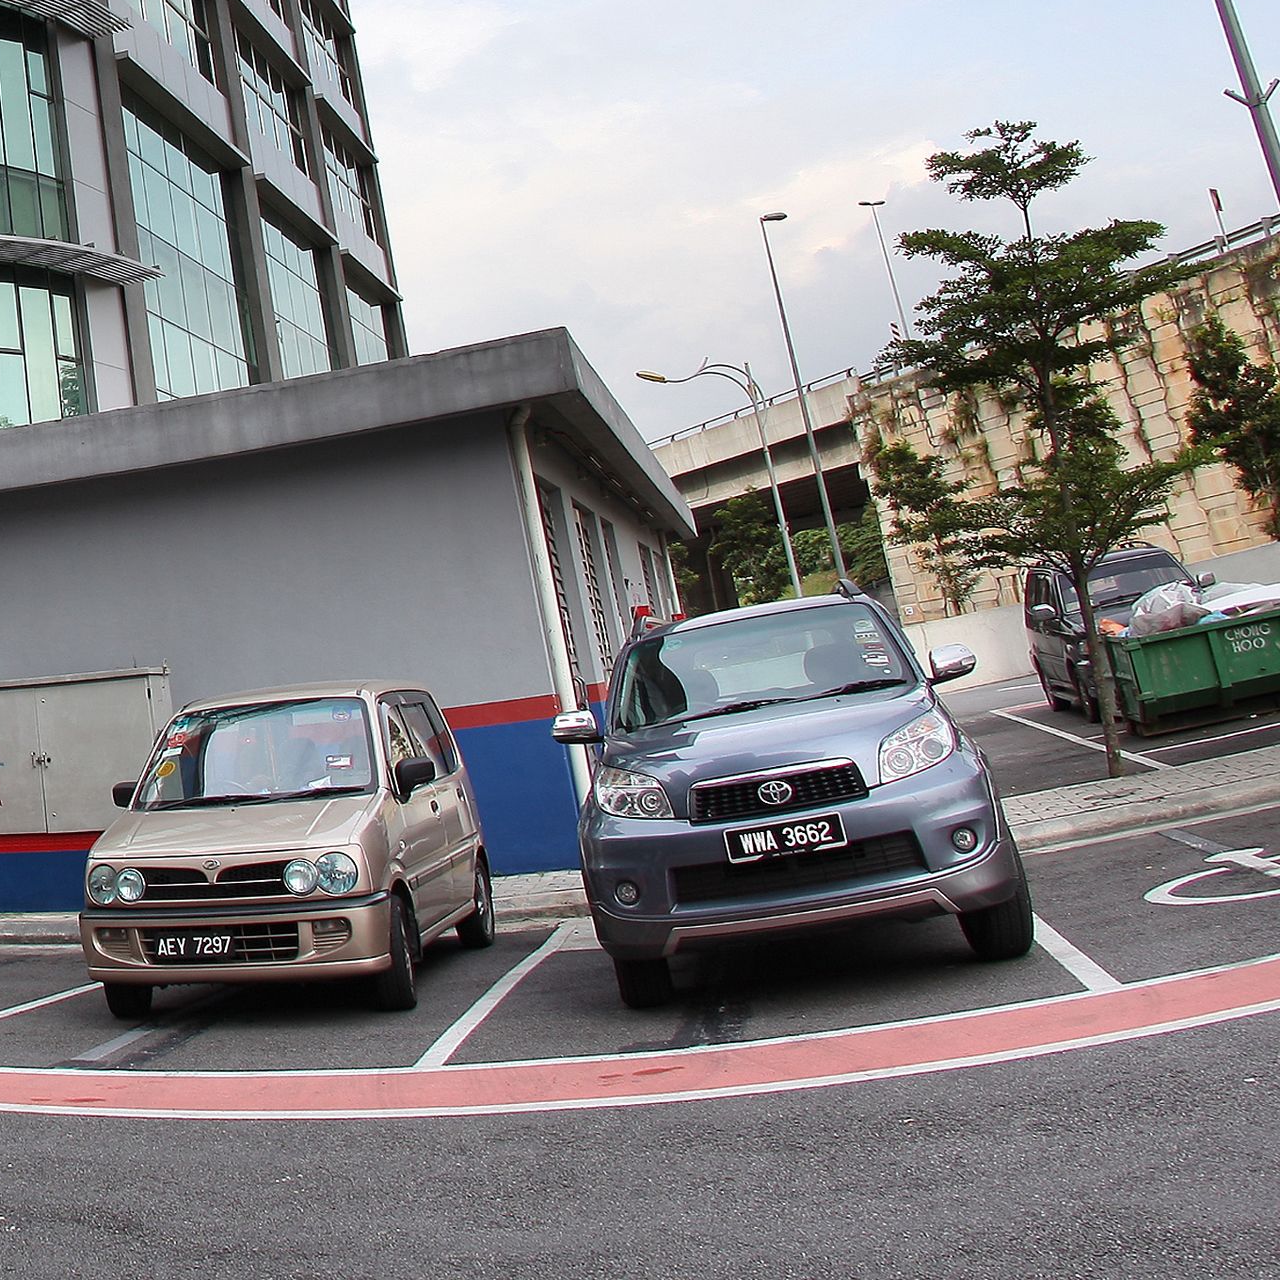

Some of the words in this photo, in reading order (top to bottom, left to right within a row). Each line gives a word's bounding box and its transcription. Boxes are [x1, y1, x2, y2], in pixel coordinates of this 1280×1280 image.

[1224, 623, 1271, 641] CHONG
[1232, 637, 1266, 653] HOO
[739, 830, 778, 854] WWA
[782, 821, 833, 847] 3662
[158, 937, 186, 956] AEY
[193, 936, 231, 954] 7297
